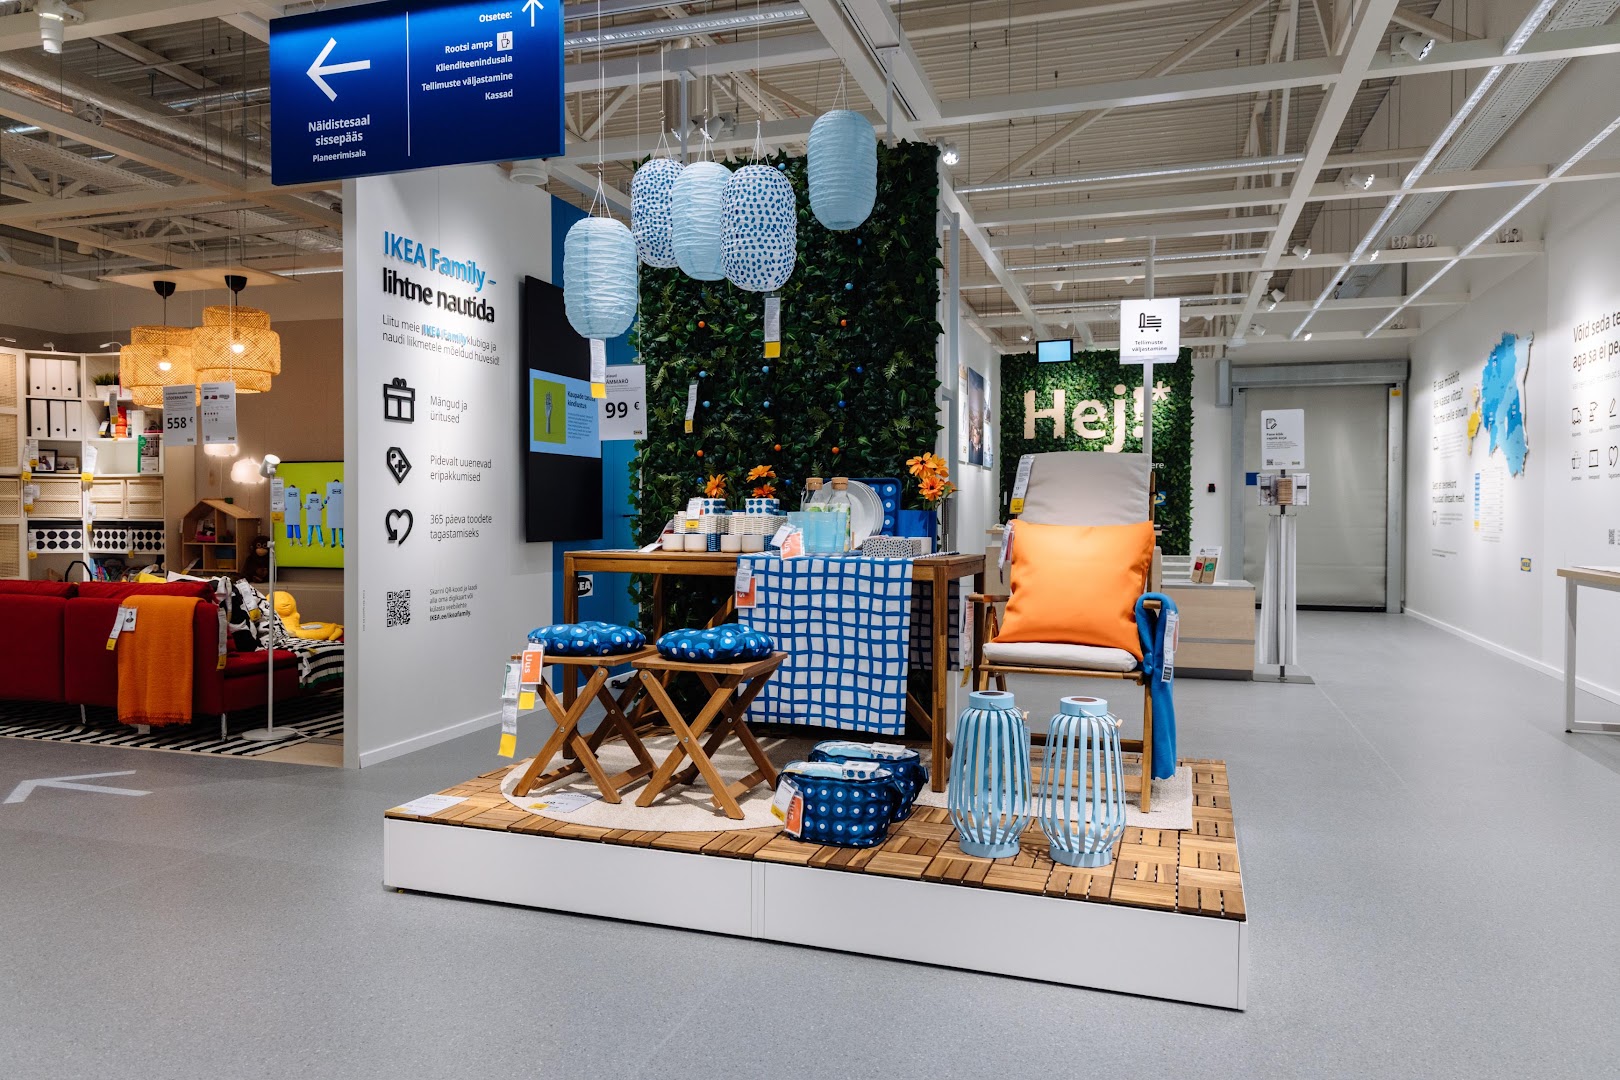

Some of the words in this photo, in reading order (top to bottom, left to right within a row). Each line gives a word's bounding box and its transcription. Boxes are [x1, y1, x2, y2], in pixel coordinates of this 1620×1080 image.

[479, 10, 512, 23] Otsetee:
[445, 43, 469, 54] Rootsi
[471, 39, 493, 52] amps
[436, 54, 513, 72] Klienditeenindusala
[421, 78, 461, 91] Tellimuste
[462, 71, 513, 87] väljastamine
[485, 89, 513, 100] Kassad
[308, 115, 370, 133] Näidistesaal
[315, 132, 363, 147] sissepääs
[312, 149, 366, 162] Planeerimisala
[384, 231, 427, 268] IKEA
[430, 248, 486, 292] Family
[383, 267, 433, 305] lihtne
[437, 291, 495, 322] nautida
[382, 314, 400, 328] Liitu
[401, 320, 420, 333] meie
[421, 324, 440, 338] IKEA
[467, 336, 489, 351] klubiga
[491, 342, 497, 353] ja
[1573, 320, 1590, 343] Võid
[1591, 313, 1610, 336] seda
[1612, 311, 1620, 327] te
[382, 332, 405, 345] naudi
[406, 335, 442, 352] liikmetele
[443, 345, 473, 360] mõeldud
[1573, 352, 1586, 372] aga
[1589, 349, 1597, 363] sa
[1599, 340, 1606, 359] ei
[1608, 340, 1620, 362] pe
[430, 395, 460, 410] Mängud
[461, 400, 468, 412] ja
[605, 402, 628, 418] 99
[634, 401, 640, 410] €
[167, 417, 187, 429] 558
[430, 411, 460, 424] üritused
[430, 455, 458, 467] Pidevalt
[460, 458, 492, 469] uuenevad
[430, 470, 481, 483] eripakkumised
[430, 514, 444, 525] 365
[445, 514, 466, 526] päeva
[467, 514, 492, 525] toodete
[430, 529, 480, 542] tagastamiseks
[524, 654, 533, 673] Uus
